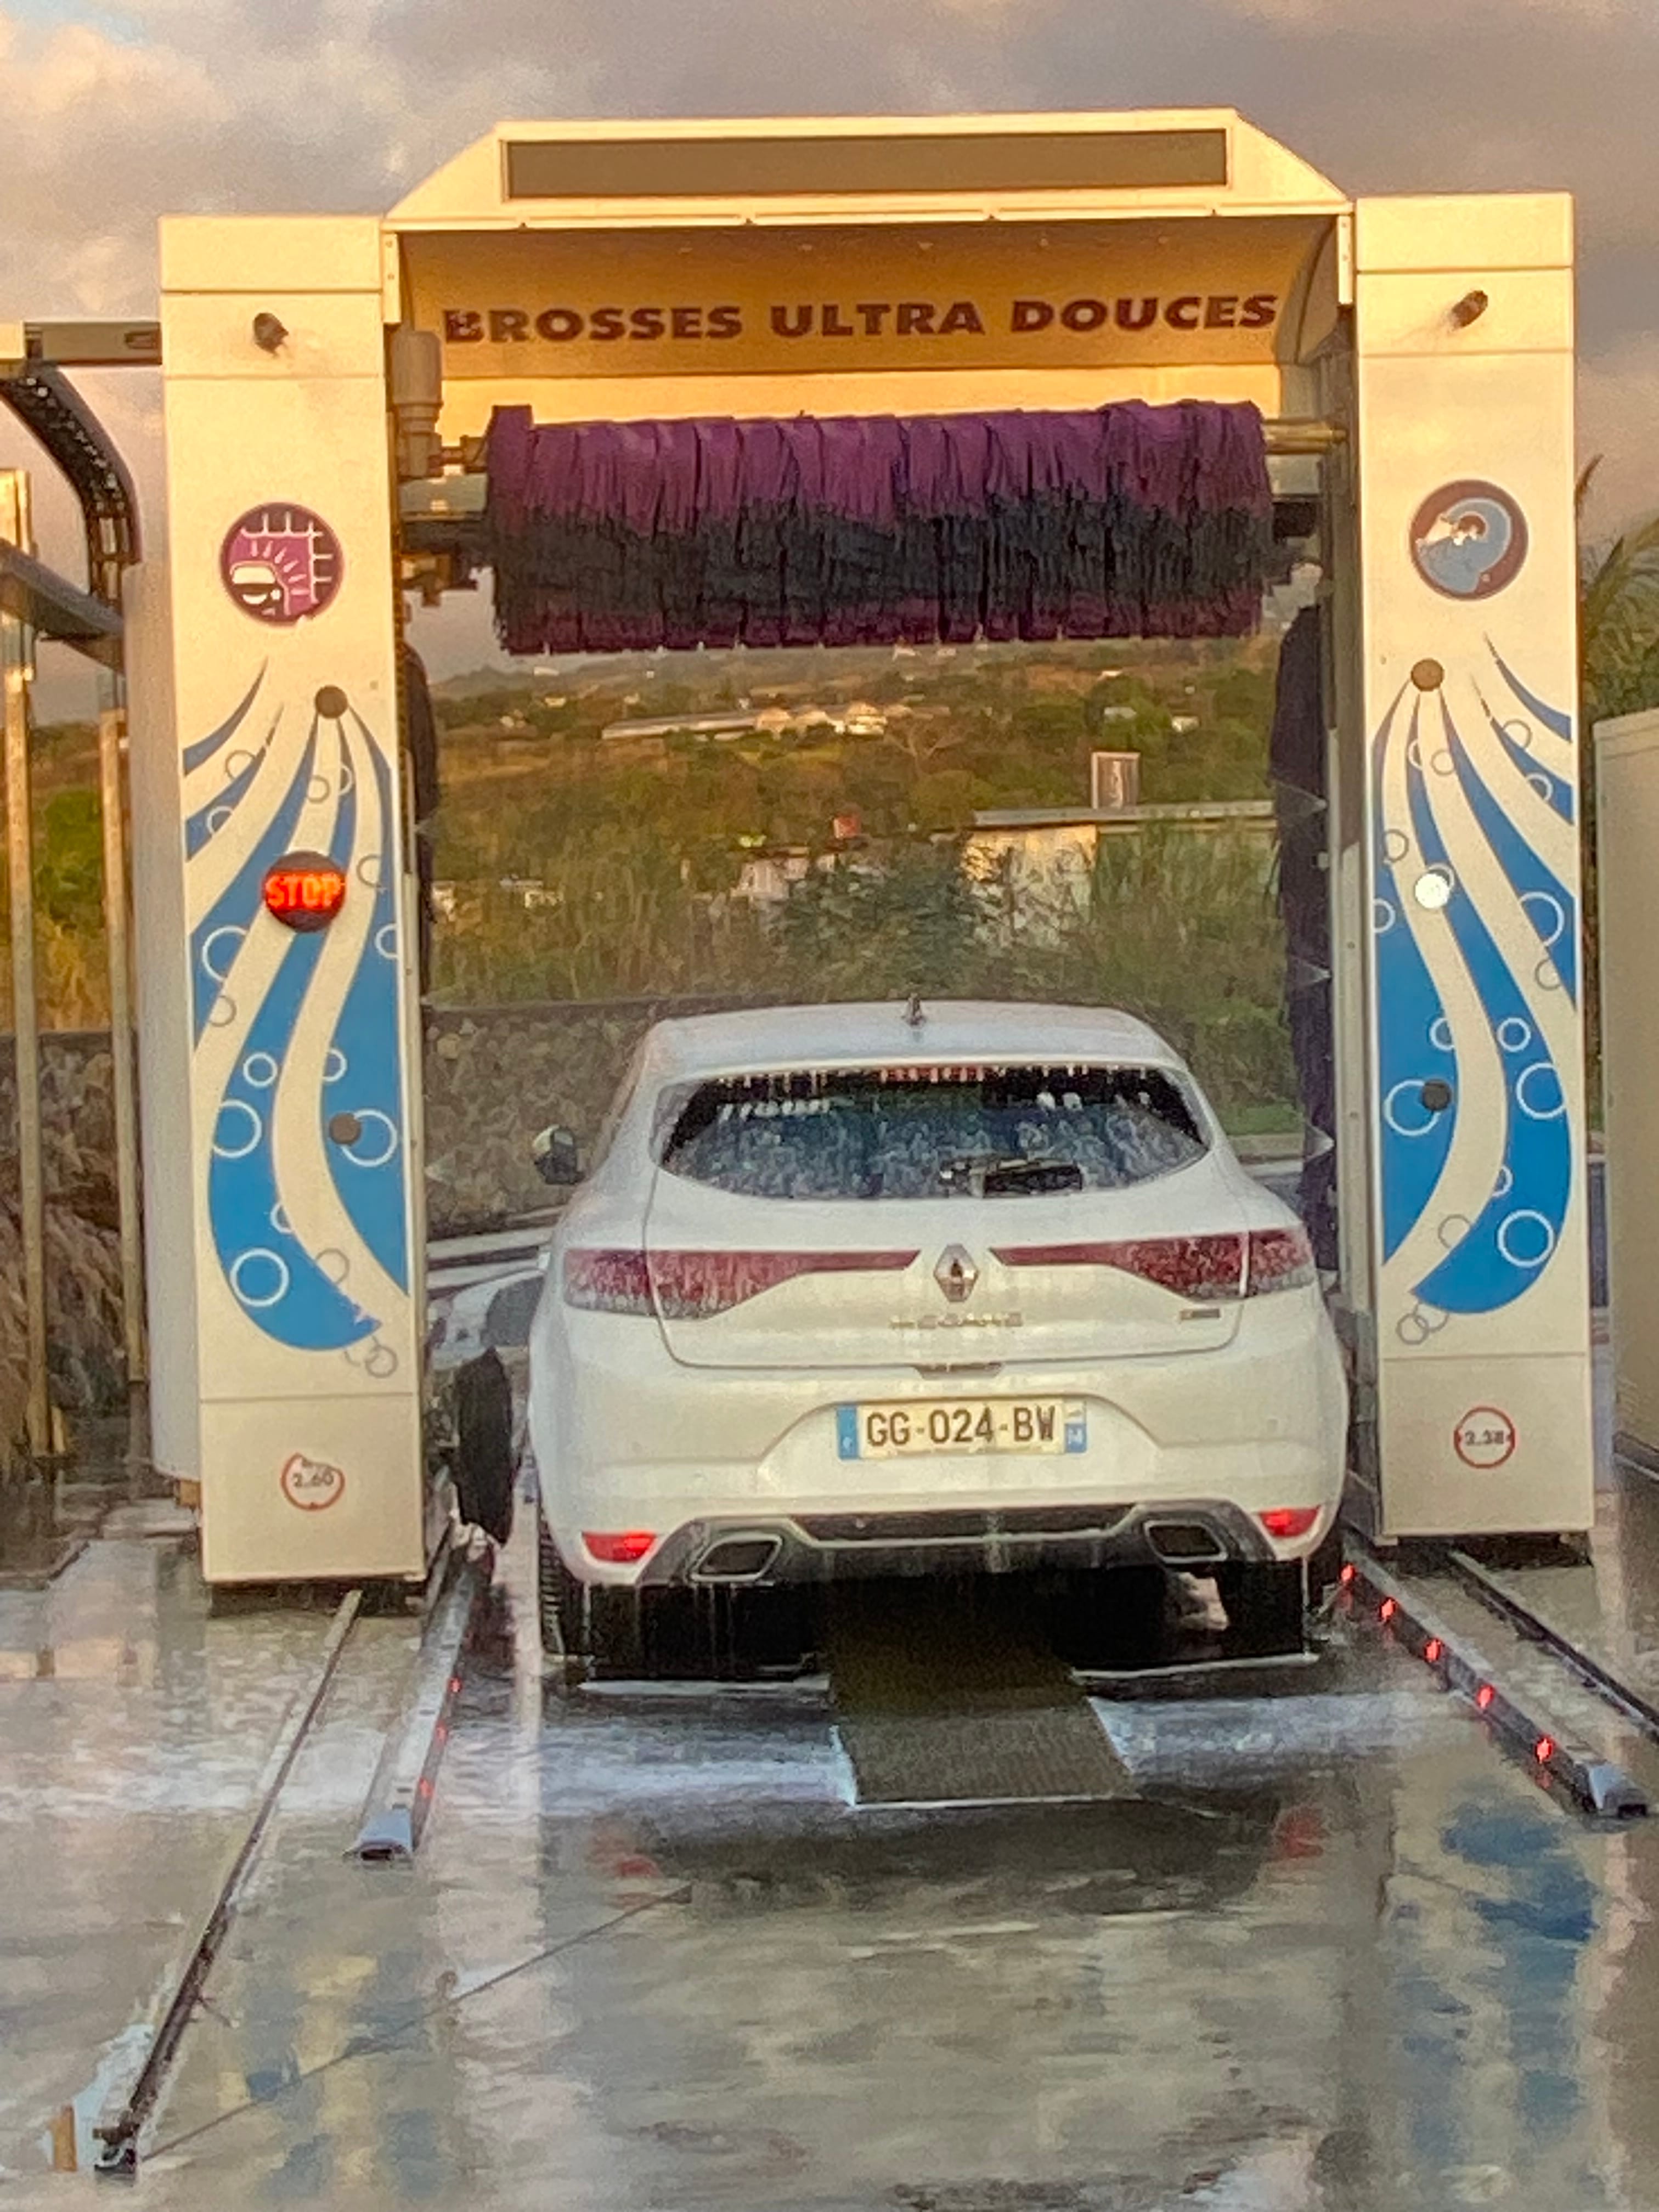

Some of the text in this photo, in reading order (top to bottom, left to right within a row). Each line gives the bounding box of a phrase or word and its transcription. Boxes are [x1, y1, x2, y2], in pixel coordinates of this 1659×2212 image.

[442, 294, 1279, 344] BROSSES ULTRA DOUCES
[266, 872, 341, 908] STOP
[867, 1405, 1055, 1447] GG-024-BW
